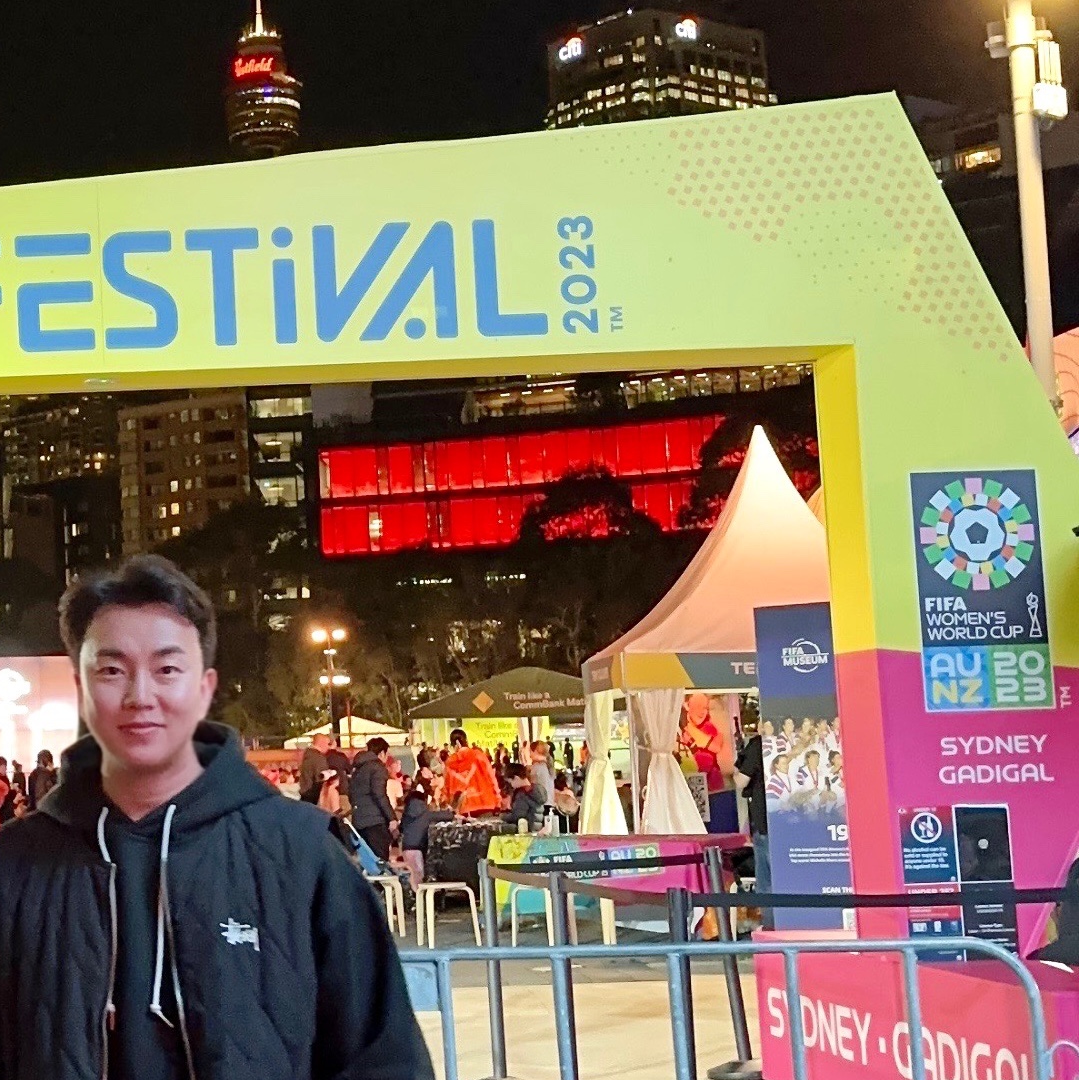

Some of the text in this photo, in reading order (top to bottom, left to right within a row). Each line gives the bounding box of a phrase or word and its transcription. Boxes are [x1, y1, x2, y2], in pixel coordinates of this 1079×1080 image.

[558, 37, 583, 61] citi
[556, 215, 599, 334] 2023
[925, 596, 967, 612] FIFA
[926, 611, 1007, 627] WOMEN'S
[927, 625, 1024, 641] WORLD CUP
[782, 647, 804, 656] FIFA
[783, 654, 828, 666] MUSEUM
[730, 662, 758, 675] TE
[930, 652, 982, 678] AU
[993, 650, 1045, 676] 20
[503, 692, 526, 700] Train
[527, 691, 543, 699] like
[932, 678, 984, 704] NZ
[996, 676, 1047, 703] 23
[940, 734, 1049, 756] SYDNEY
[938, 763, 1055, 785] GADIGAL
[767, 987, 871, 1065] SDNEY
